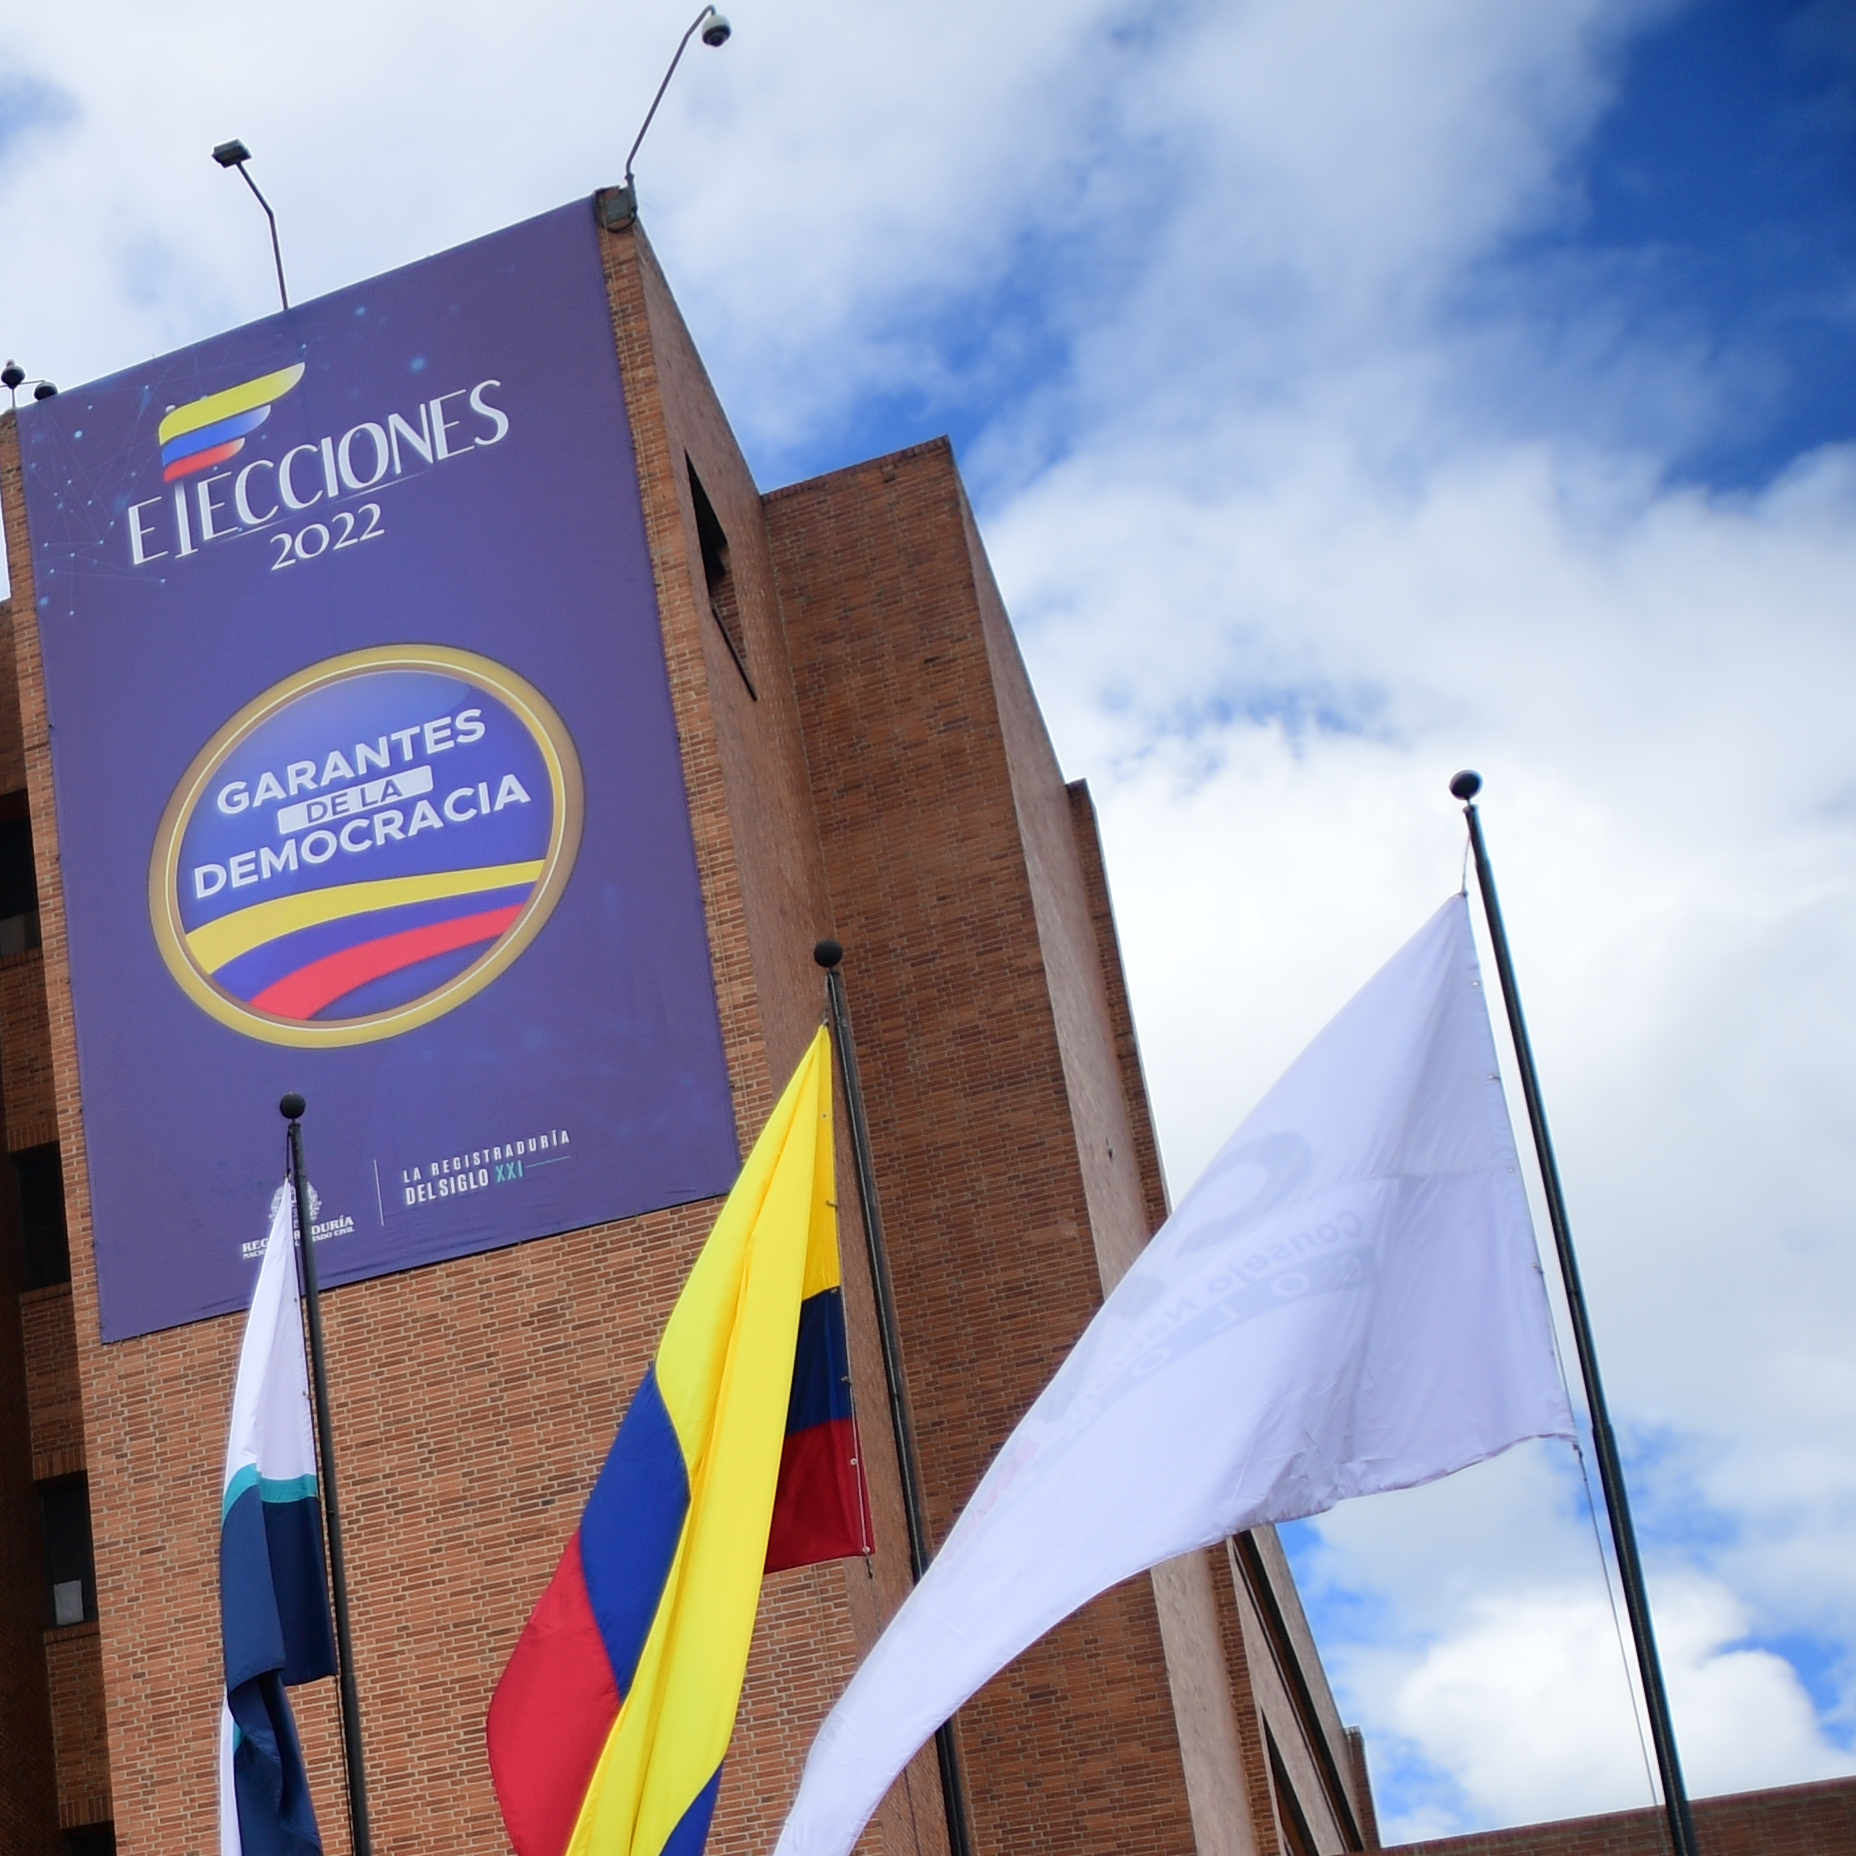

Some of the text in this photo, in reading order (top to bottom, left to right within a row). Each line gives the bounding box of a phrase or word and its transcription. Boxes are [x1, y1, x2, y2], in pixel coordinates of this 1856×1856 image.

[270, 503, 385, 571] 2022
[217, 709, 486, 815] GARANTES
[306, 780, 404, 825] DE LA
[193, 774, 532, 899] DEMOCRACIA
[403, 1129, 571, 1184] LA REGISTRADURÍA
[405, 1159, 525, 1207] DEL SIGLO XXI
